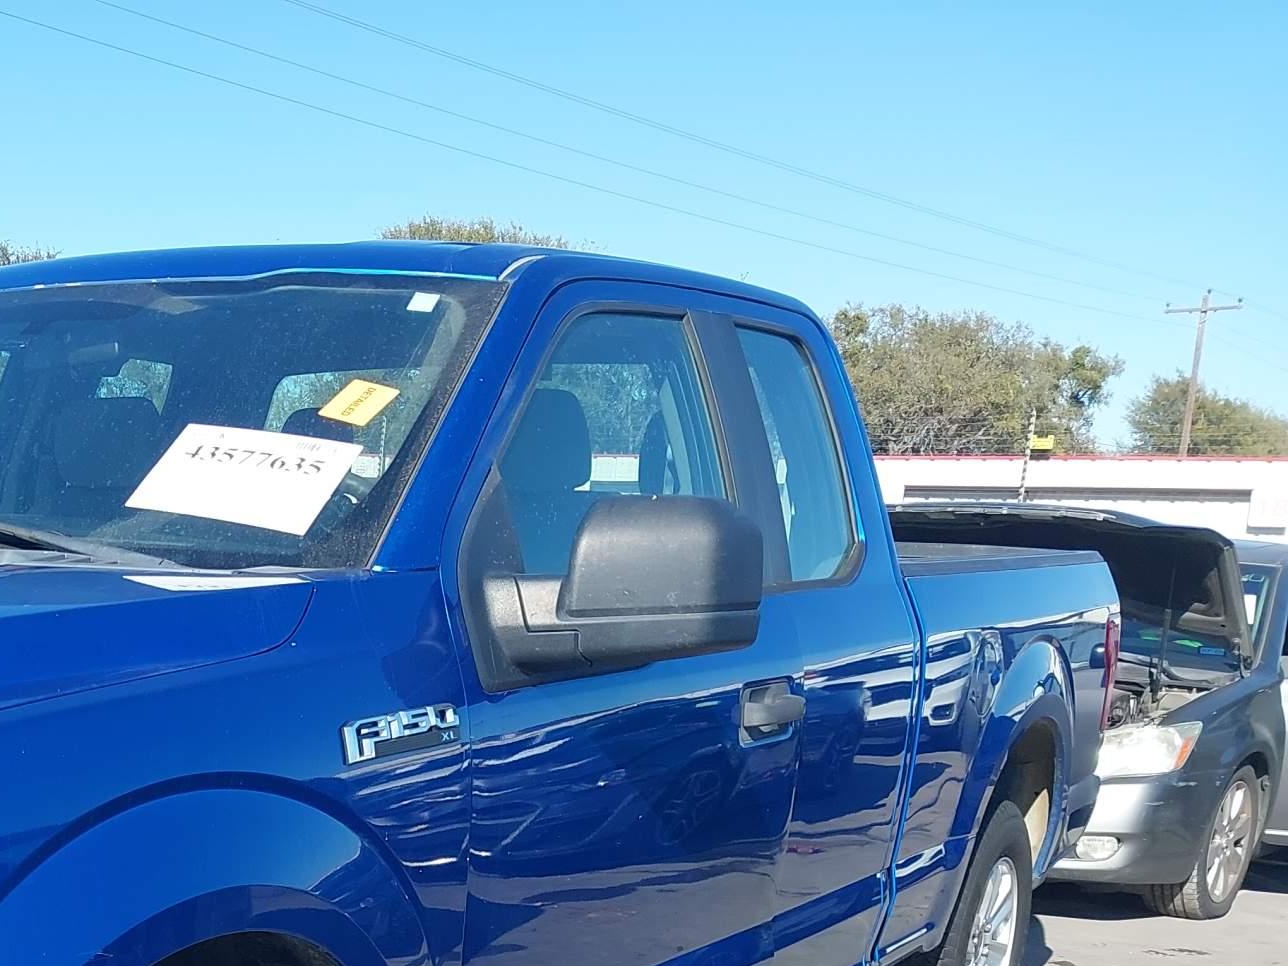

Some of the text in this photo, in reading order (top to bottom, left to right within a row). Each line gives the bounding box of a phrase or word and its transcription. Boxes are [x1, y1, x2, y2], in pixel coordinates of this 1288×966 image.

[341, 387, 377, 417] DETAILED
[185, 444, 325, 475] 43577635
[441, 731, 458, 742] XL
